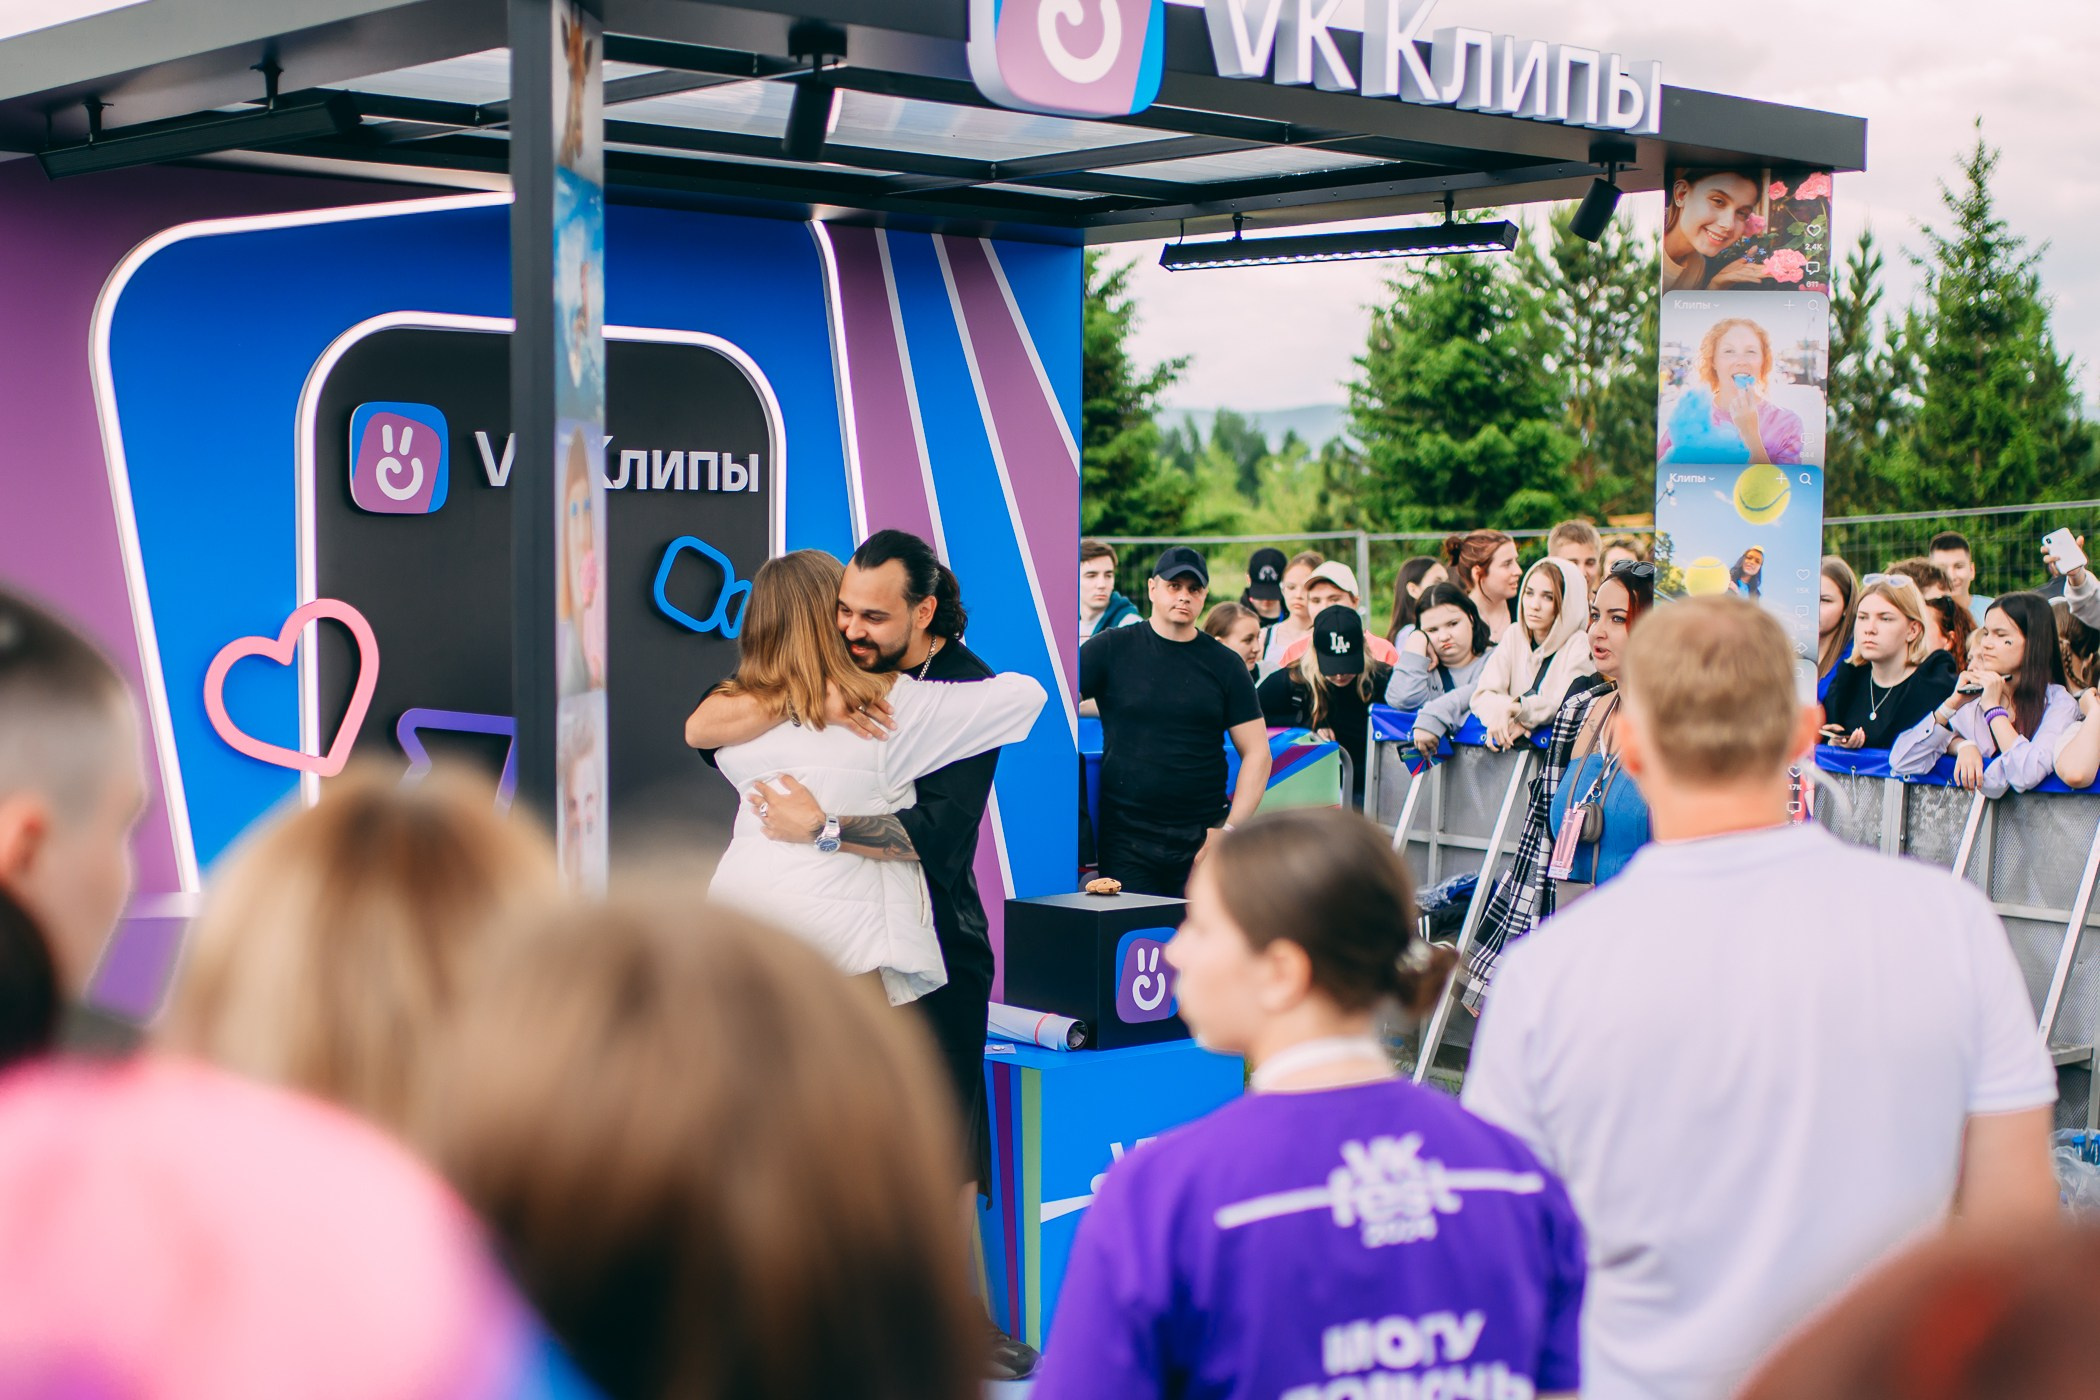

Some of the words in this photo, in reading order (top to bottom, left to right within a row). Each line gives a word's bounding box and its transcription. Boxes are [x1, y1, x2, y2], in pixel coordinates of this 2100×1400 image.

[1208, 0, 1356, 89] VK
[1366, 0, 1662, 134] Клипы
[1674, 299, 1712, 310] Клипы
[1669, 472, 1706, 483] Клипы
[1329, 631, 1350, 654] LA
